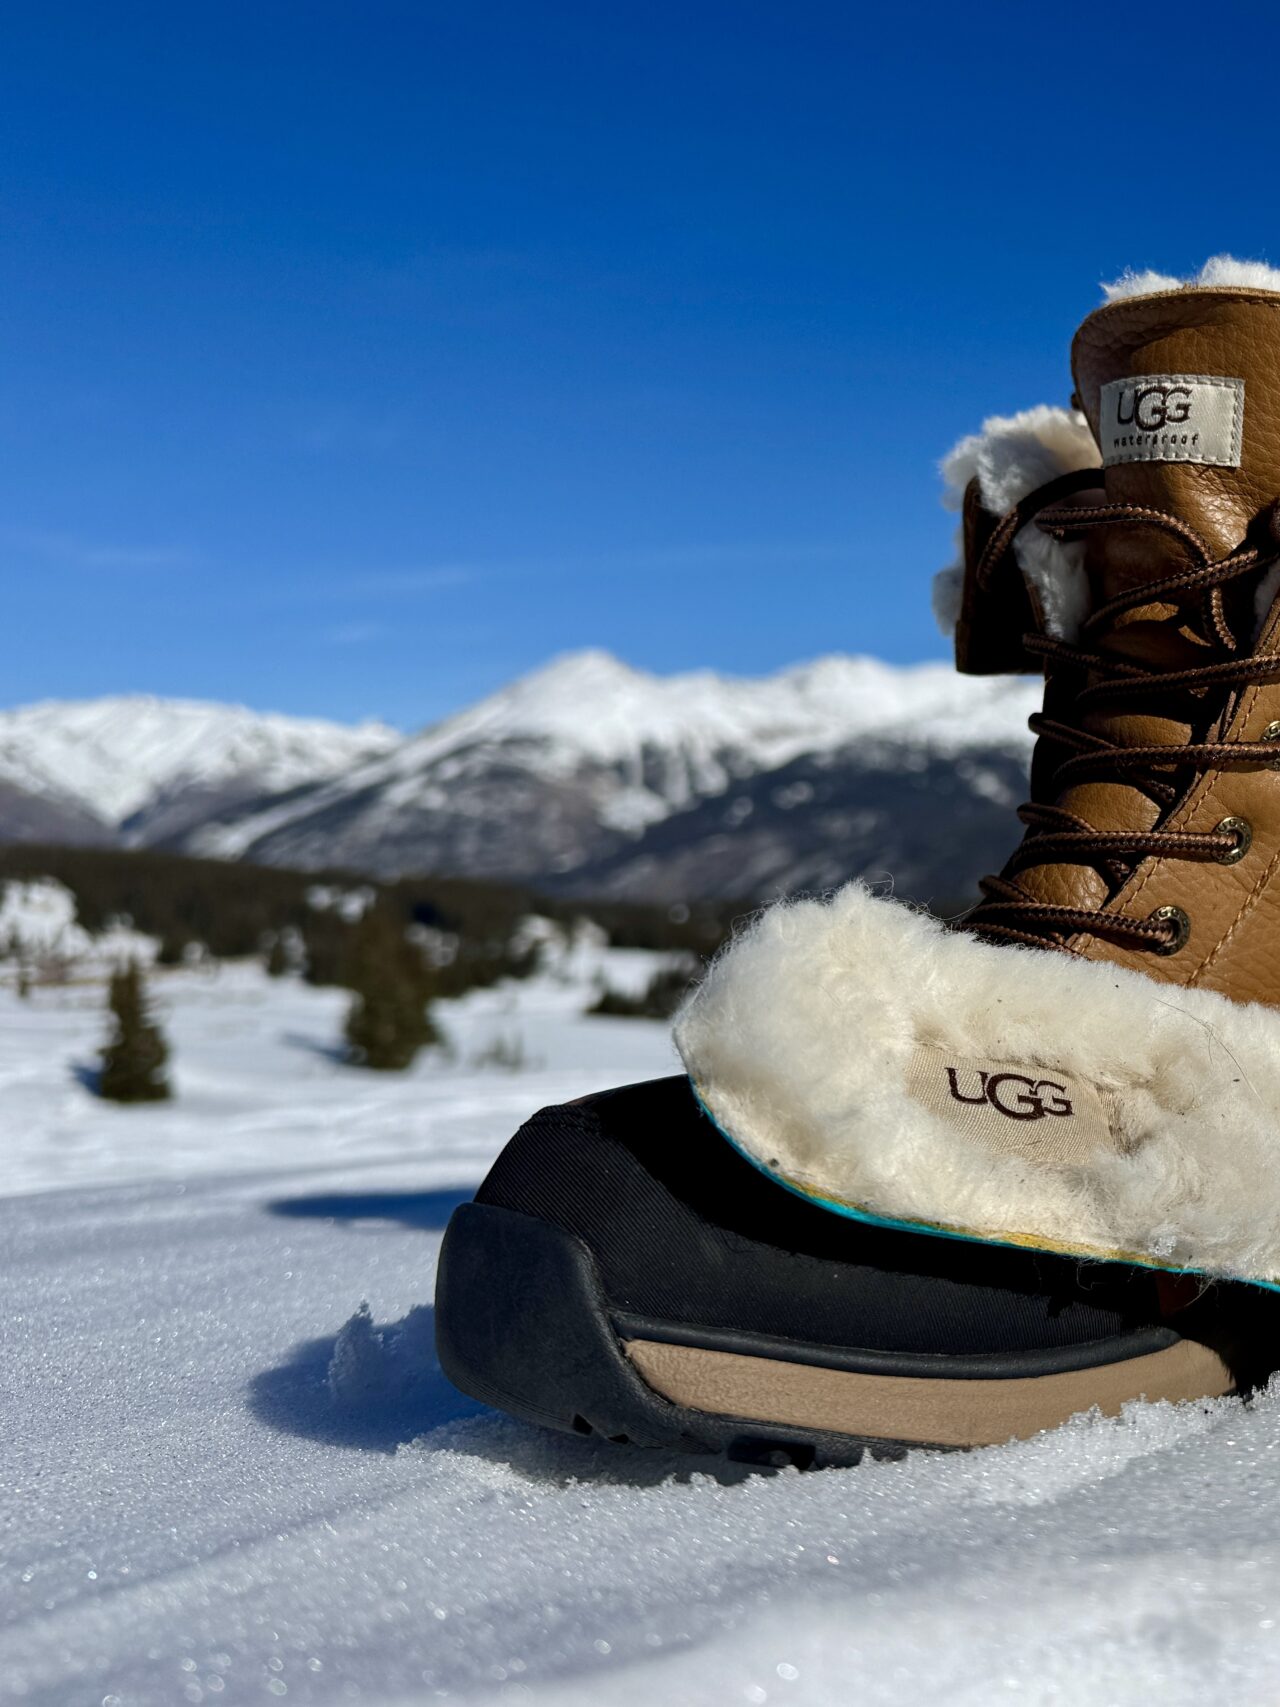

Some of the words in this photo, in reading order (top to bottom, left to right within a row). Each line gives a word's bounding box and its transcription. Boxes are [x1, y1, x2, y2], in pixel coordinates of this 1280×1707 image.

[1116, 386, 1192, 432] UGG
[1114, 433, 1200, 448] waterproof
[944, 1067, 1075, 1121] UGG
